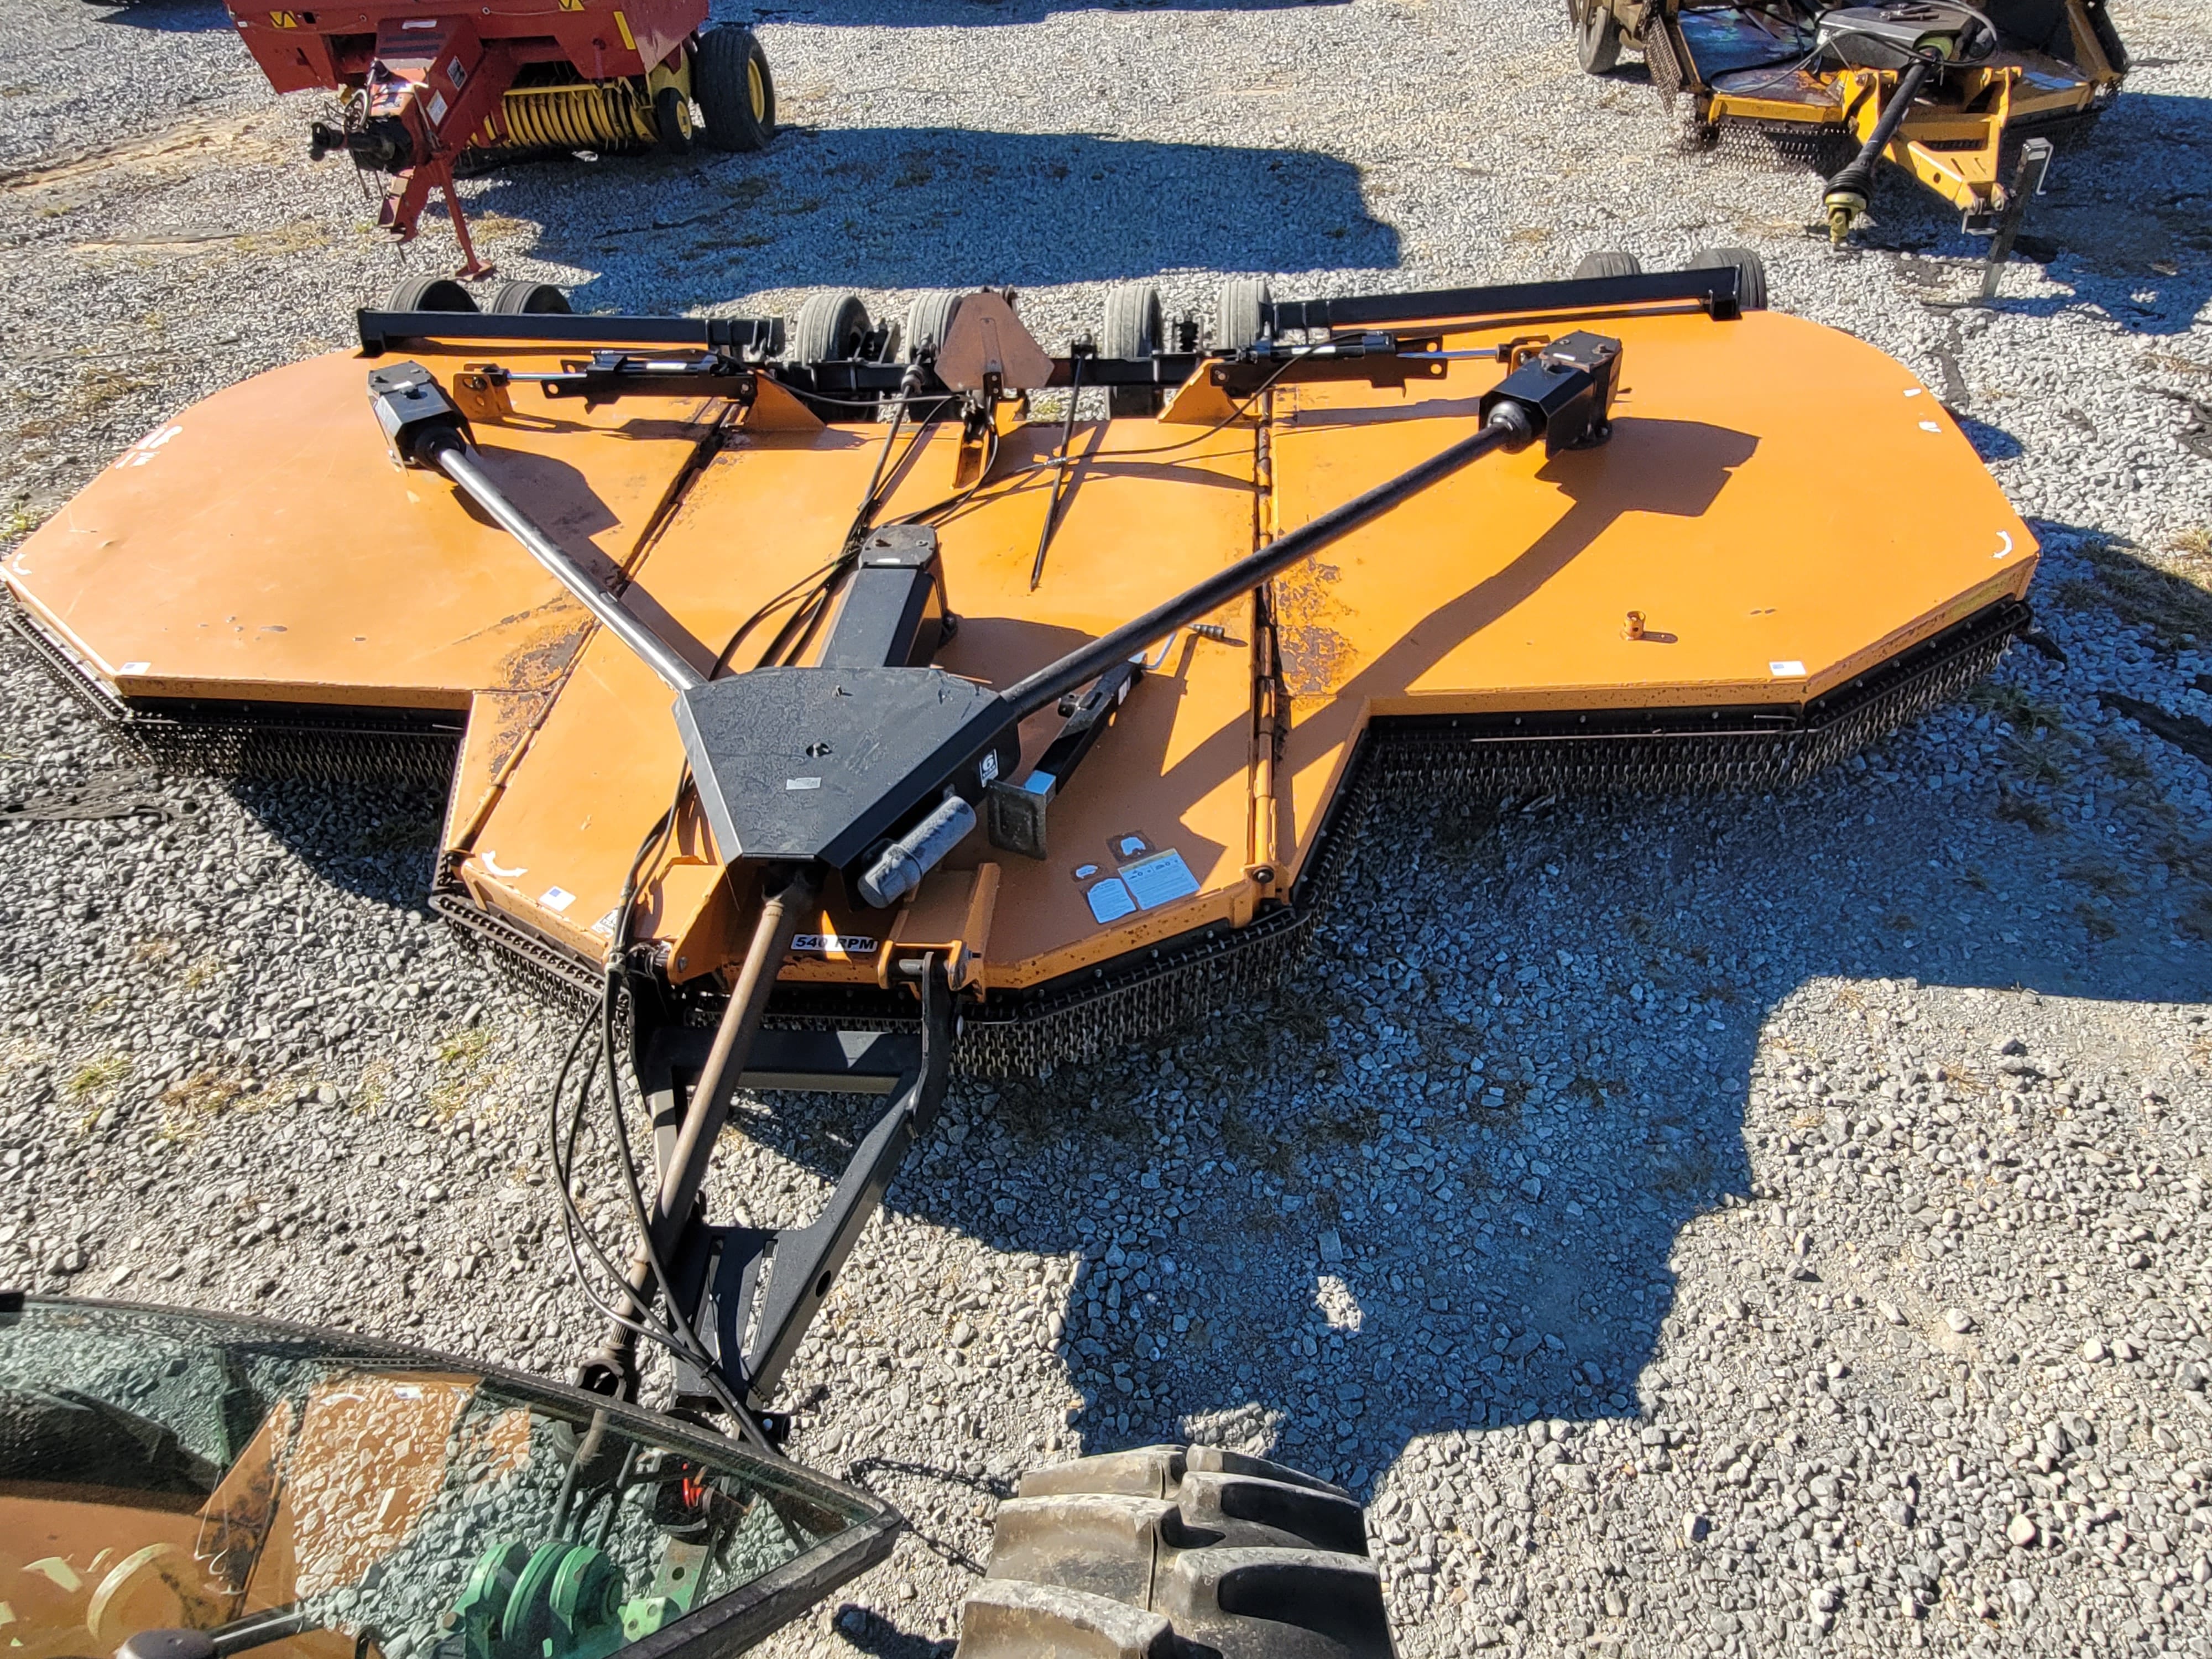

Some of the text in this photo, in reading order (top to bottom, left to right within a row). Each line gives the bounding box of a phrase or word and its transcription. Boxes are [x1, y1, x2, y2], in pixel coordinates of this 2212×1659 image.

[982, 754, 994, 771] 6
[796, 937, 874, 950] 540 RPM
